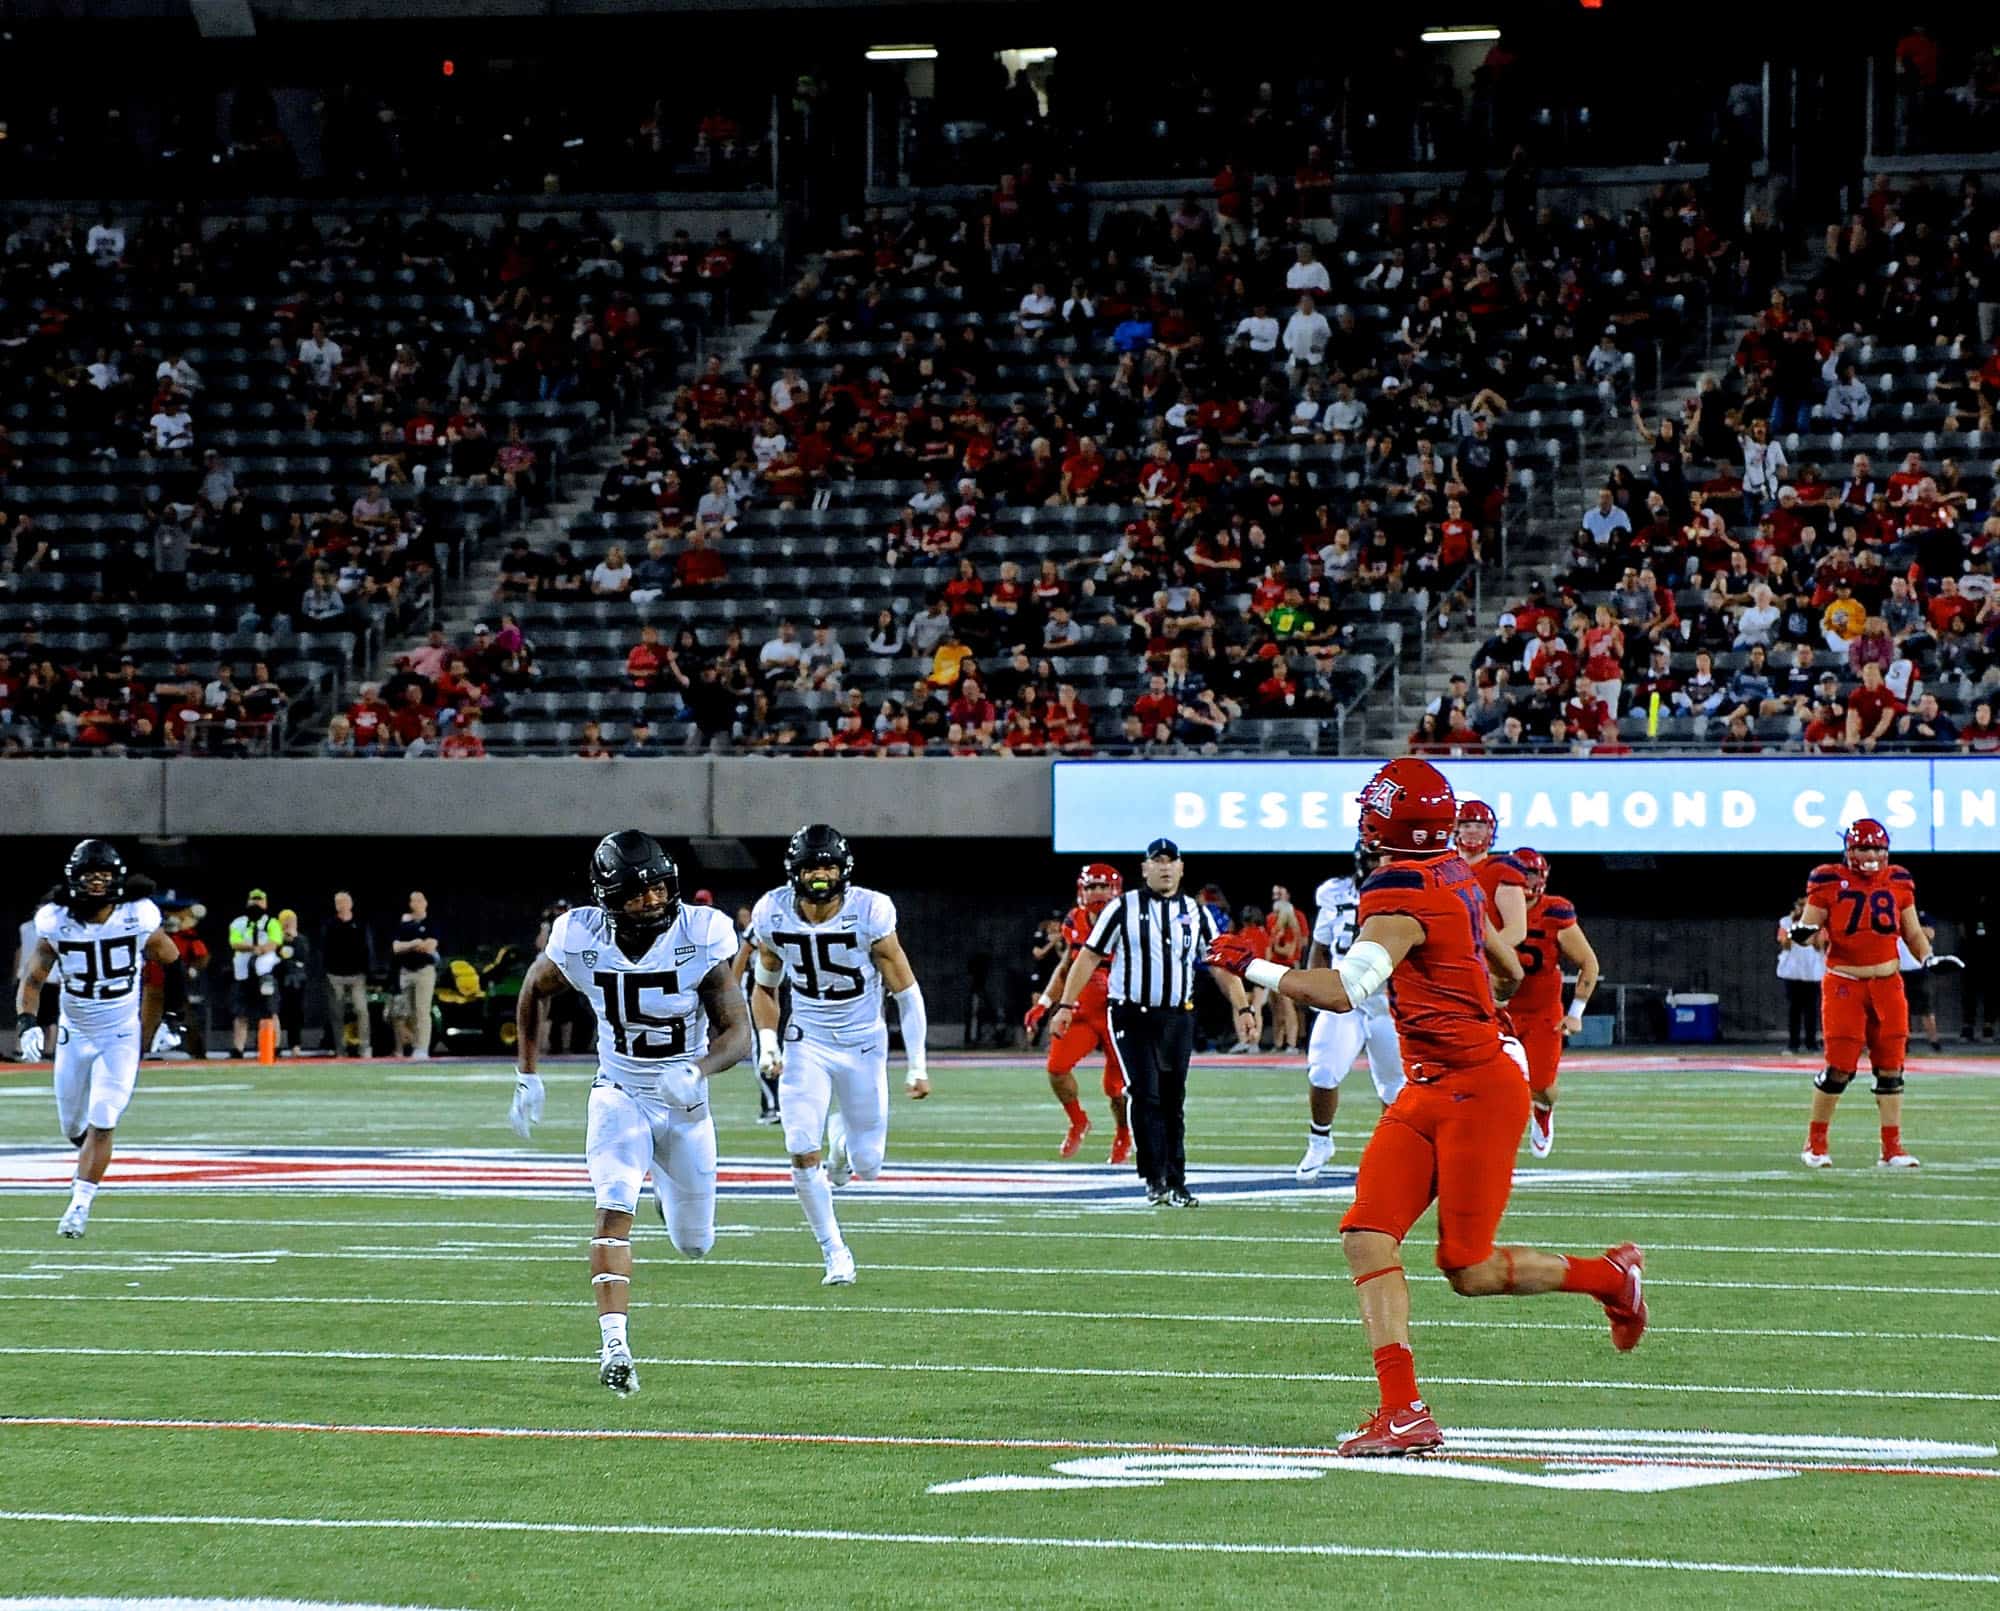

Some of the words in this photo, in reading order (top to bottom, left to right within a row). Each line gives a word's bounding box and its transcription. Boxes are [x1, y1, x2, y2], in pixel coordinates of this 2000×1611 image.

[1173, 791, 1362, 829] DESE
[1454, 791, 1757, 829] IAMOND
[1837, 889, 1898, 935] 78
[57, 934, 138, 1000] 39
[771, 931, 865, 1001] 35
[592, 970, 687, 1059] 15
